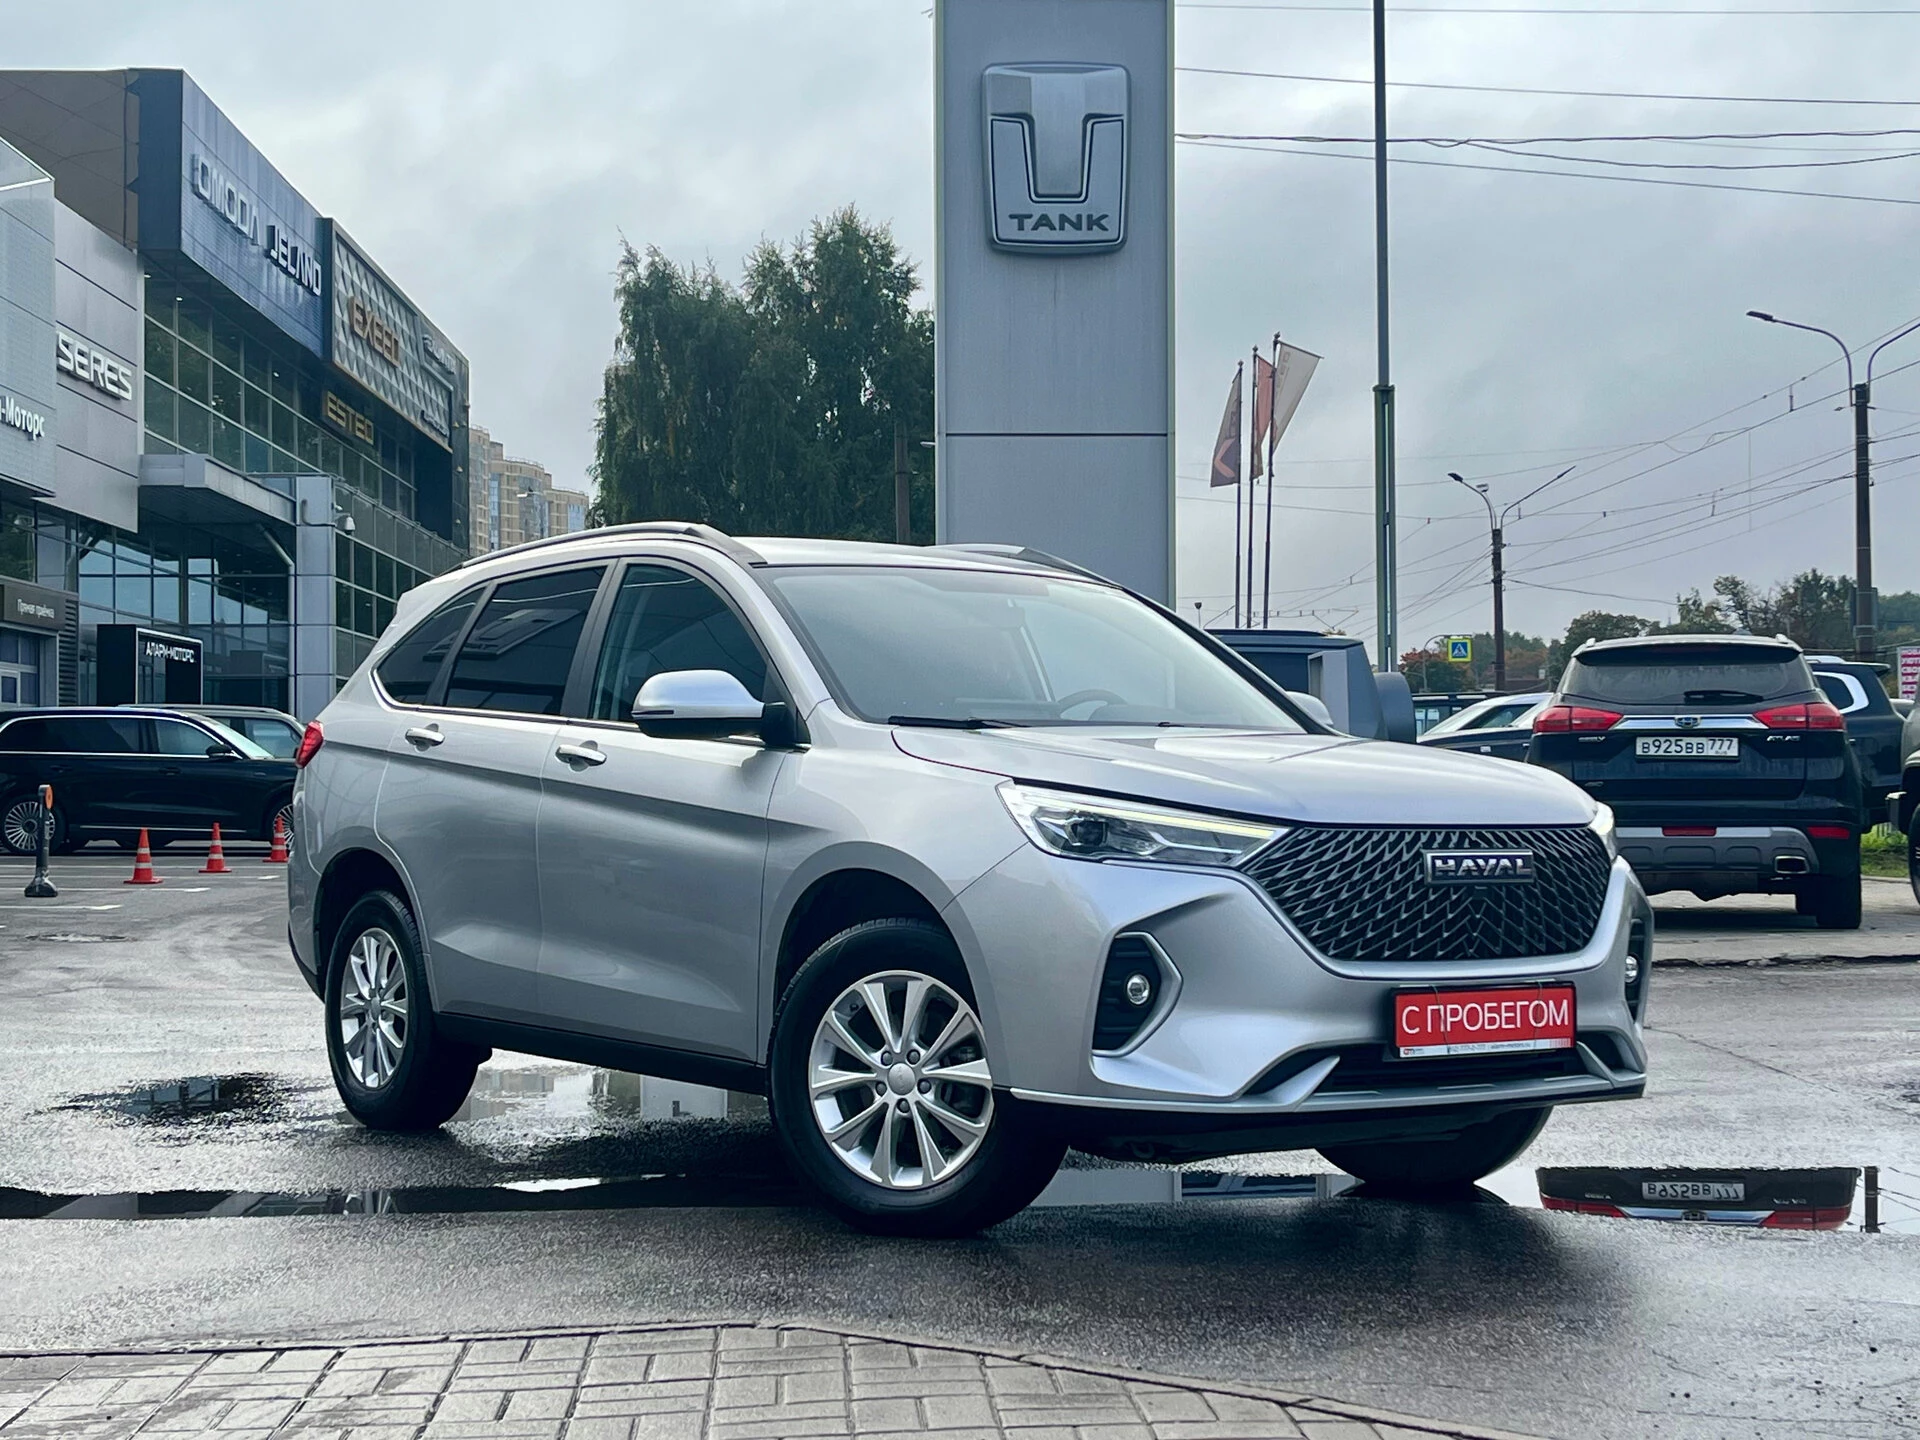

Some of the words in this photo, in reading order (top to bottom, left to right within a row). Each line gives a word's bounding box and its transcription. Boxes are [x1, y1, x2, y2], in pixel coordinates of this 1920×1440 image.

[198, 156, 260, 246] OMODA
[270, 228, 322, 297] JELAND
[1008, 213, 1109, 232] TANK
[350, 297, 400, 368] EXEED
[57, 331, 132, 401] SERES
[1708, 738, 1734, 750] 777
[1434, 858, 1532, 876] HAVAL
[1402, 1005, 1420, 1035] С
[1427, 999, 1569, 1033] ПРОБЕГОМ
